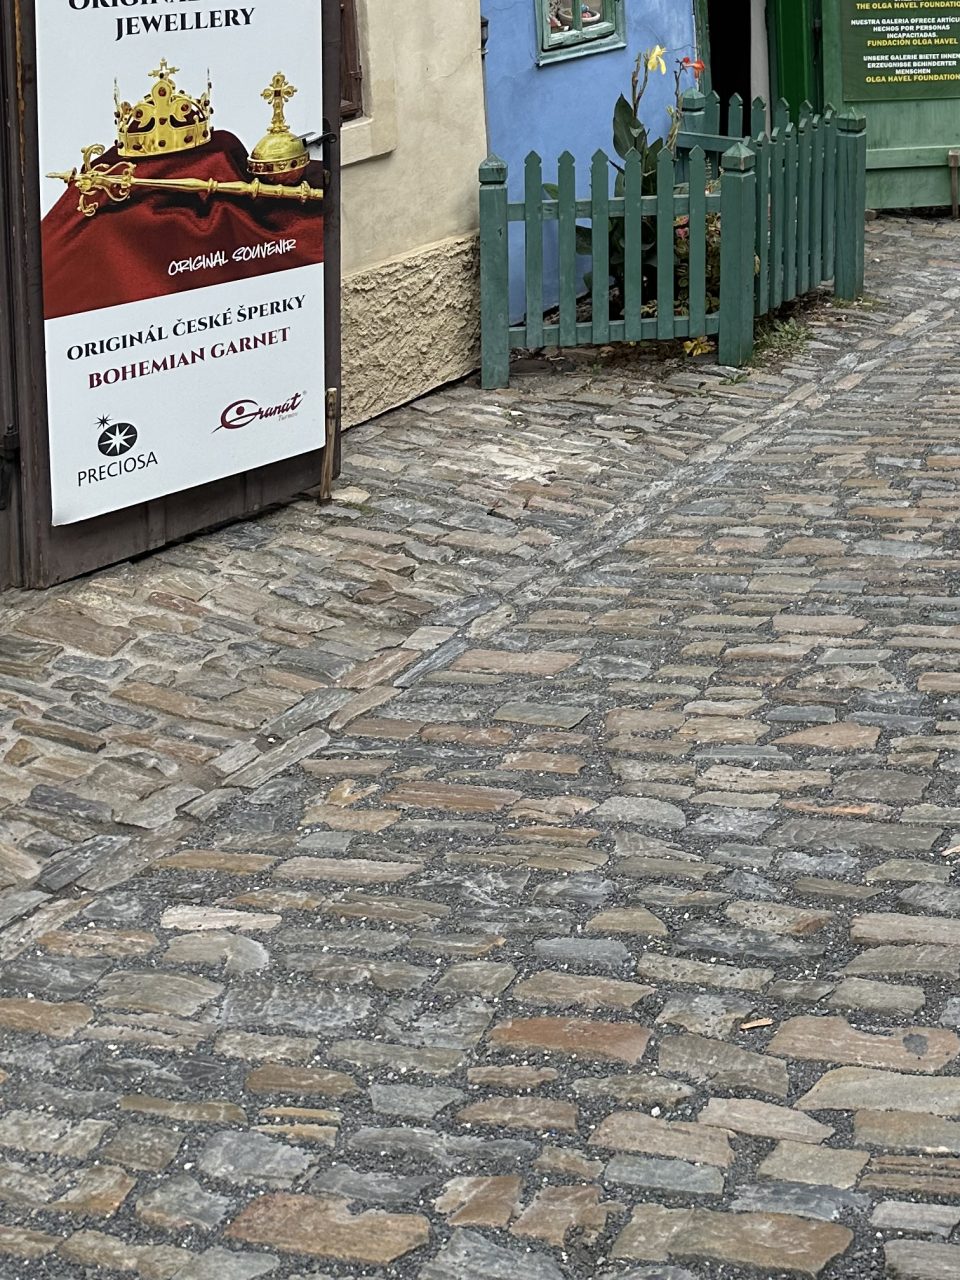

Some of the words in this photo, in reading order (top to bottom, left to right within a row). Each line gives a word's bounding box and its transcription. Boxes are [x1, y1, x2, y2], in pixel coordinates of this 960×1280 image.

[893, 1, 918, 9] HAVEL
[115, 8, 256, 42] JEWELLERY
[867, 38, 911, 47] FUNDACIÓN
[934, 37, 959, 45] HAVEL
[913, 73, 960, 82] FOUNDATION
[168, 251, 229, 276] ORIGINAL
[232, 239, 297, 262] SOUVENIR
[67, 325, 168, 361] ORIGINÁL
[172, 308, 233, 337] ČESKÉ
[236, 295, 306, 323] ŠPERKY
[88, 347, 205, 389] BOHEMIAN
[210, 327, 291, 359] GARNET
[77, 451, 159, 487] PRECIOSA
